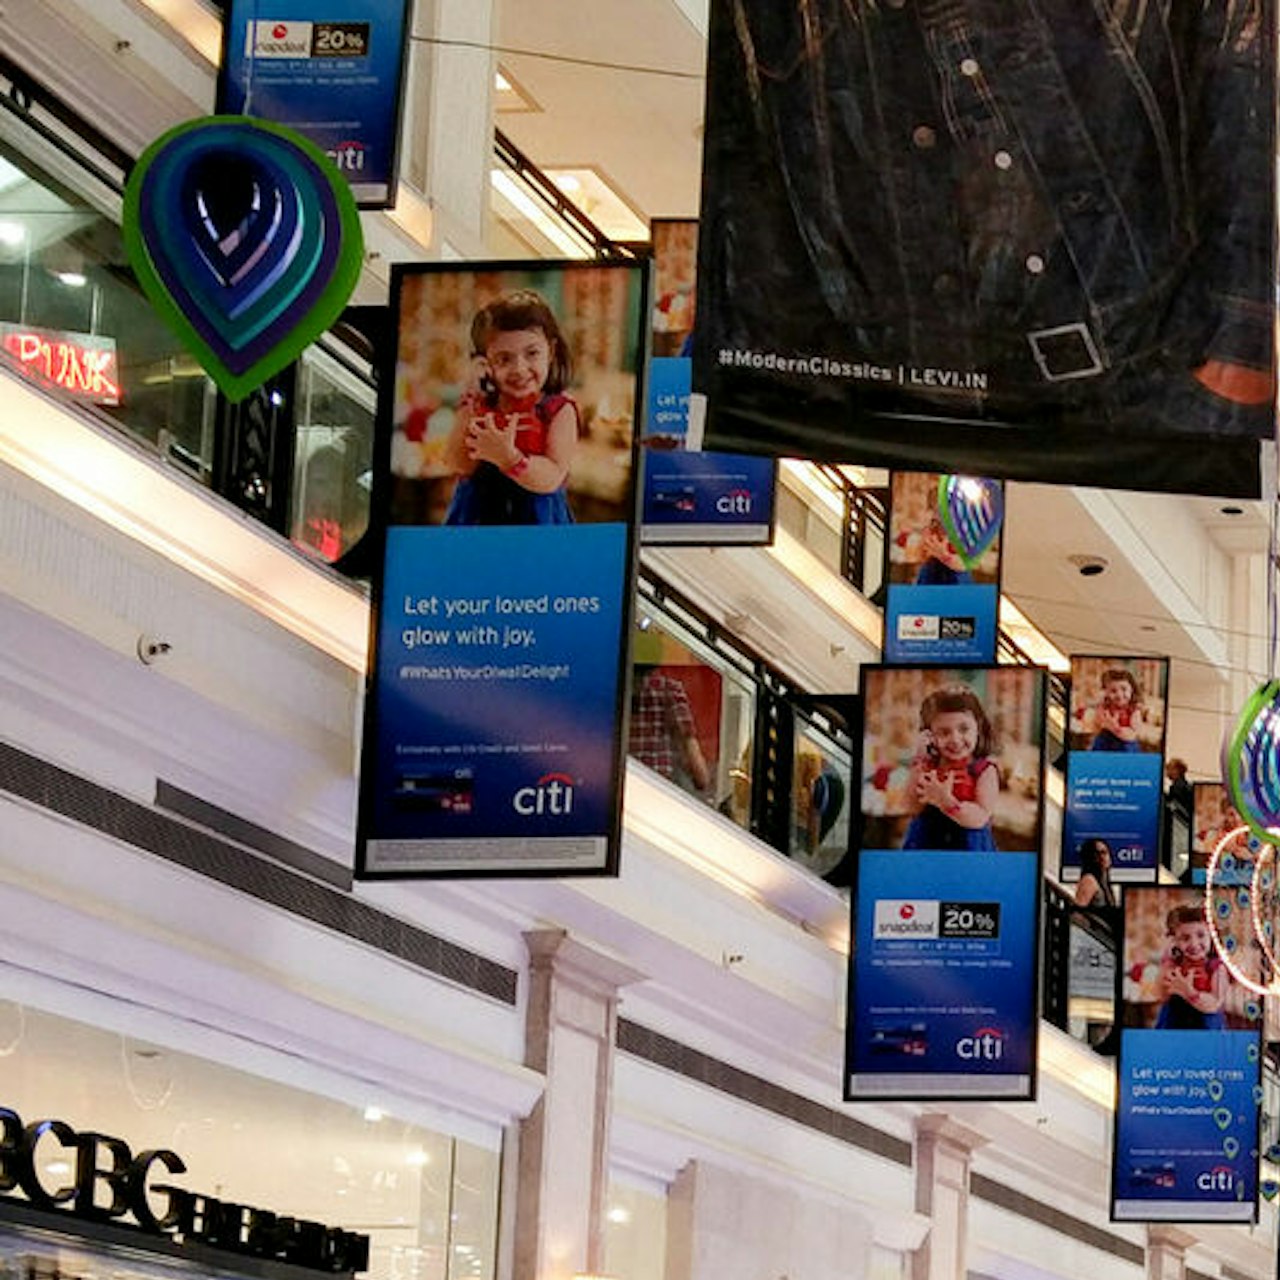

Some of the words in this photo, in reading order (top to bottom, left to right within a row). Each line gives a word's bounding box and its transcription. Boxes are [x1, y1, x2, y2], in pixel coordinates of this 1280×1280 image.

[317, 30, 363, 49] 20%
[19, 333, 117, 393] PINK
[719, 349, 892, 381] #ModernClassics
[910, 367, 988, 388] LEVI.IN
[716, 495, 751, 513] citi
[405, 596, 438, 614] Let
[445, 598, 488, 618] your
[496, 595, 548, 613] loved
[553, 596, 599, 613] ones
[402, 626, 450, 649] glow
[455, 626, 499, 645] with
[503, 627, 536, 648] joy.
[513, 780, 573, 815] citi
[1118, 848, 1144, 860] citi
[879, 920, 934, 935] snapdeal
[944, 911, 995, 930] 20%
[957, 1034, 1003, 1059] citi
[1132, 1068, 1153, 1080] Let
[1155, 1069, 1182, 1081] your
[1184, 1069, 1215, 1080] loved
[1132, 1084, 1159, 1097] glow
[1162, 1084, 1187, 1096] with
[1197, 1171, 1232, 1190] citi
